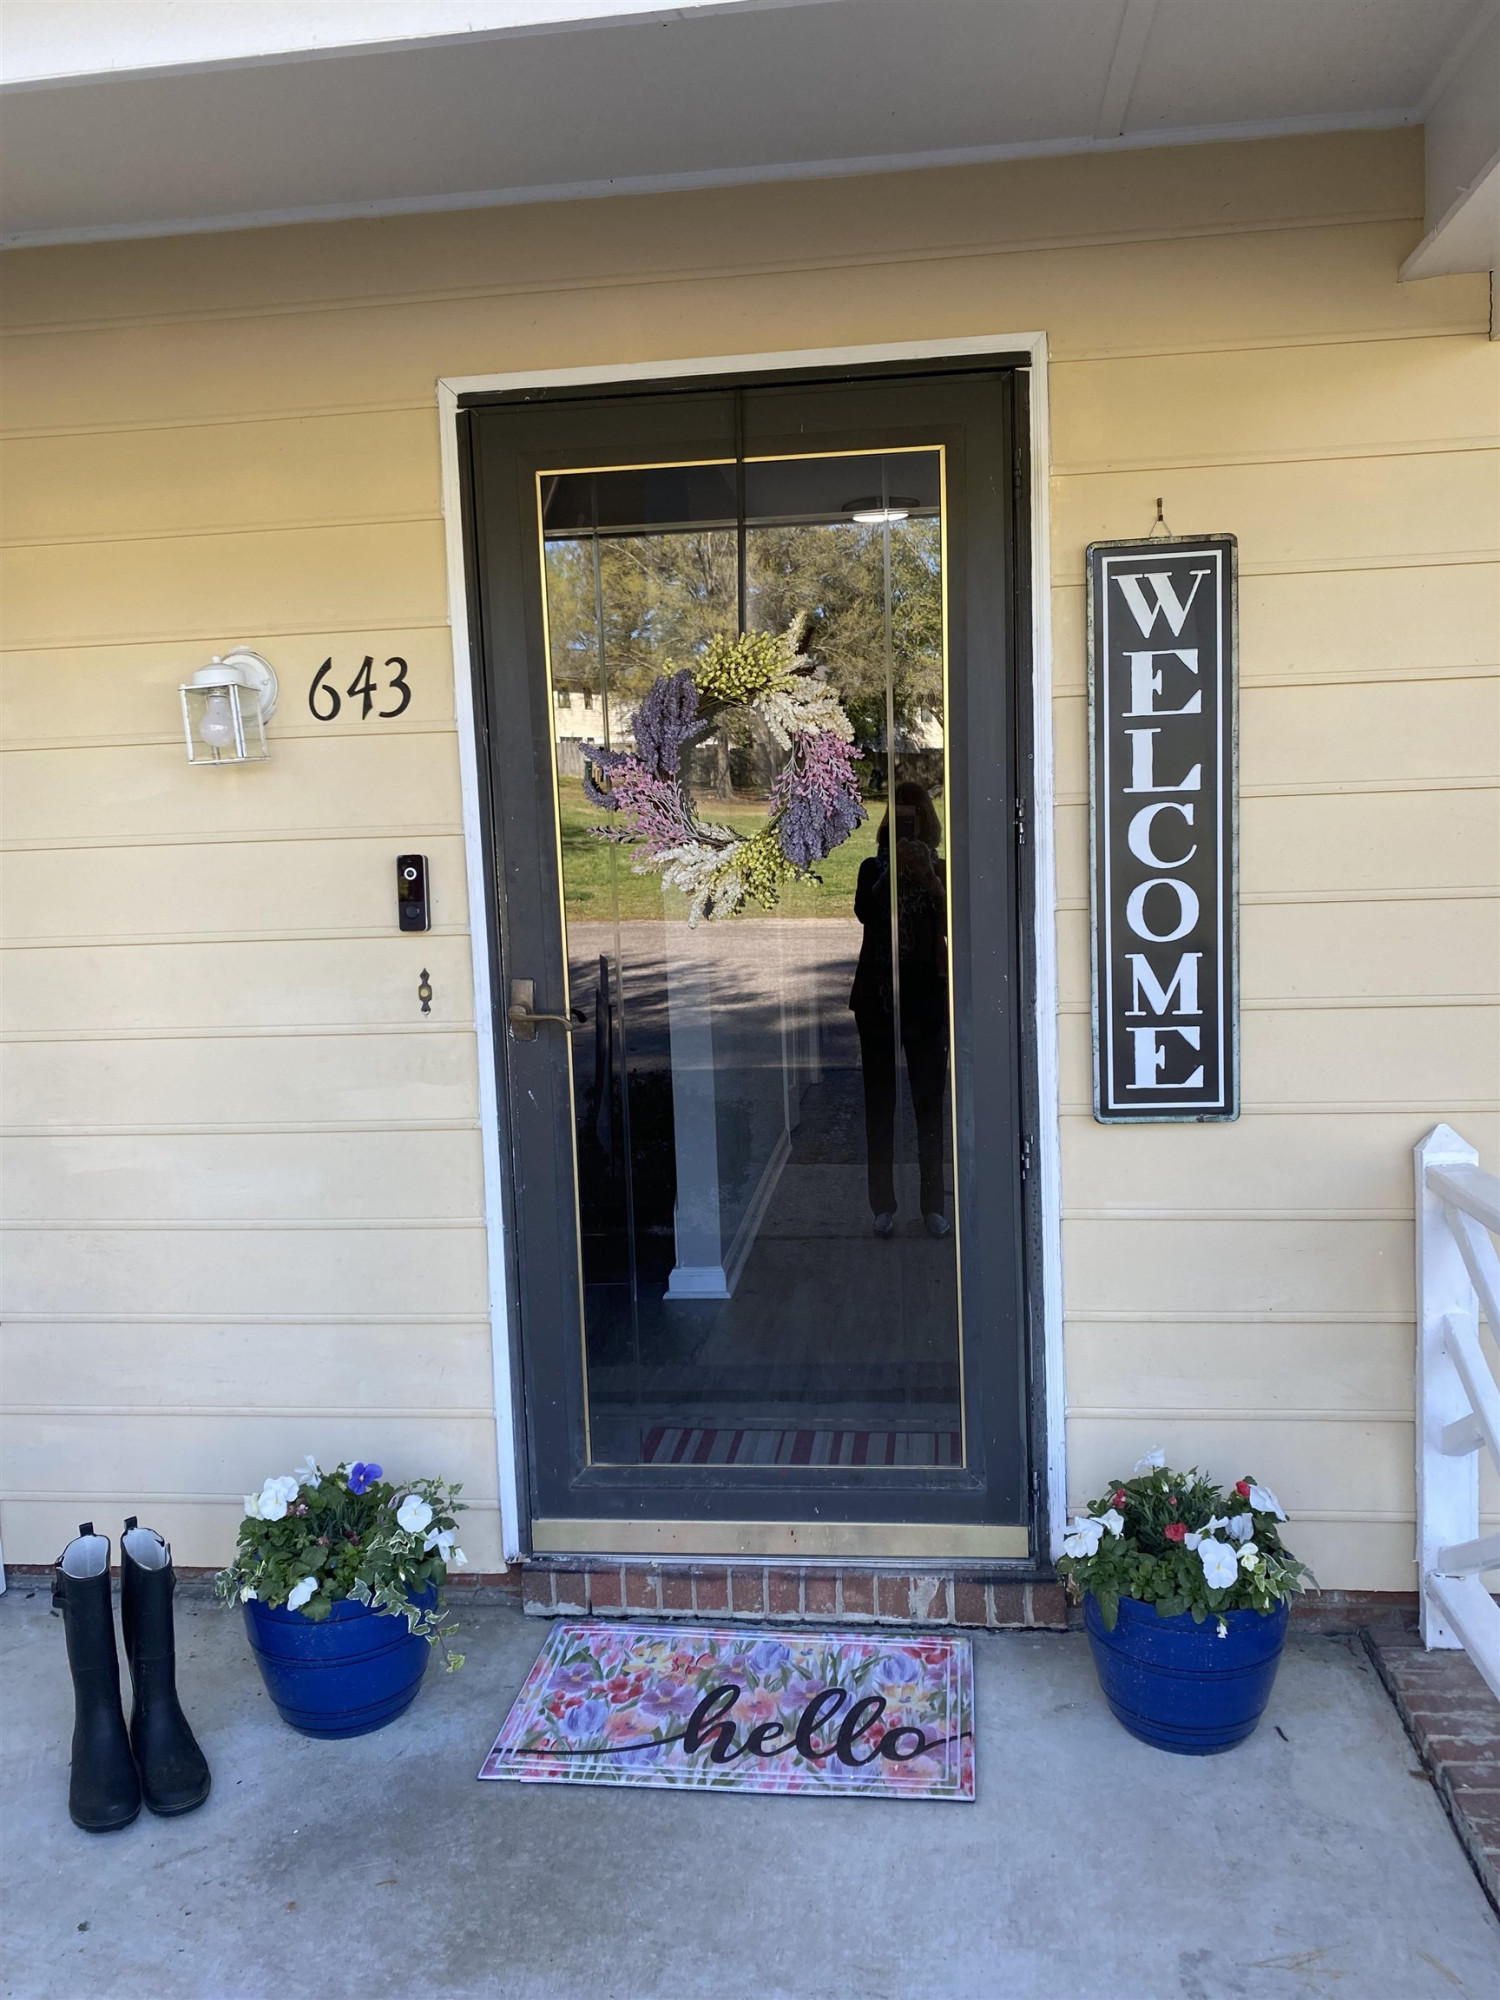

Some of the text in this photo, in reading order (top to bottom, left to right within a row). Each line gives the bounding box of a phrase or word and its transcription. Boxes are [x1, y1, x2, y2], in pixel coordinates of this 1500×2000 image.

[308, 655, 412, 721] 643
[1111, 569, 1212, 1089] WELCOME
[683, 1684, 972, 1767] hello
